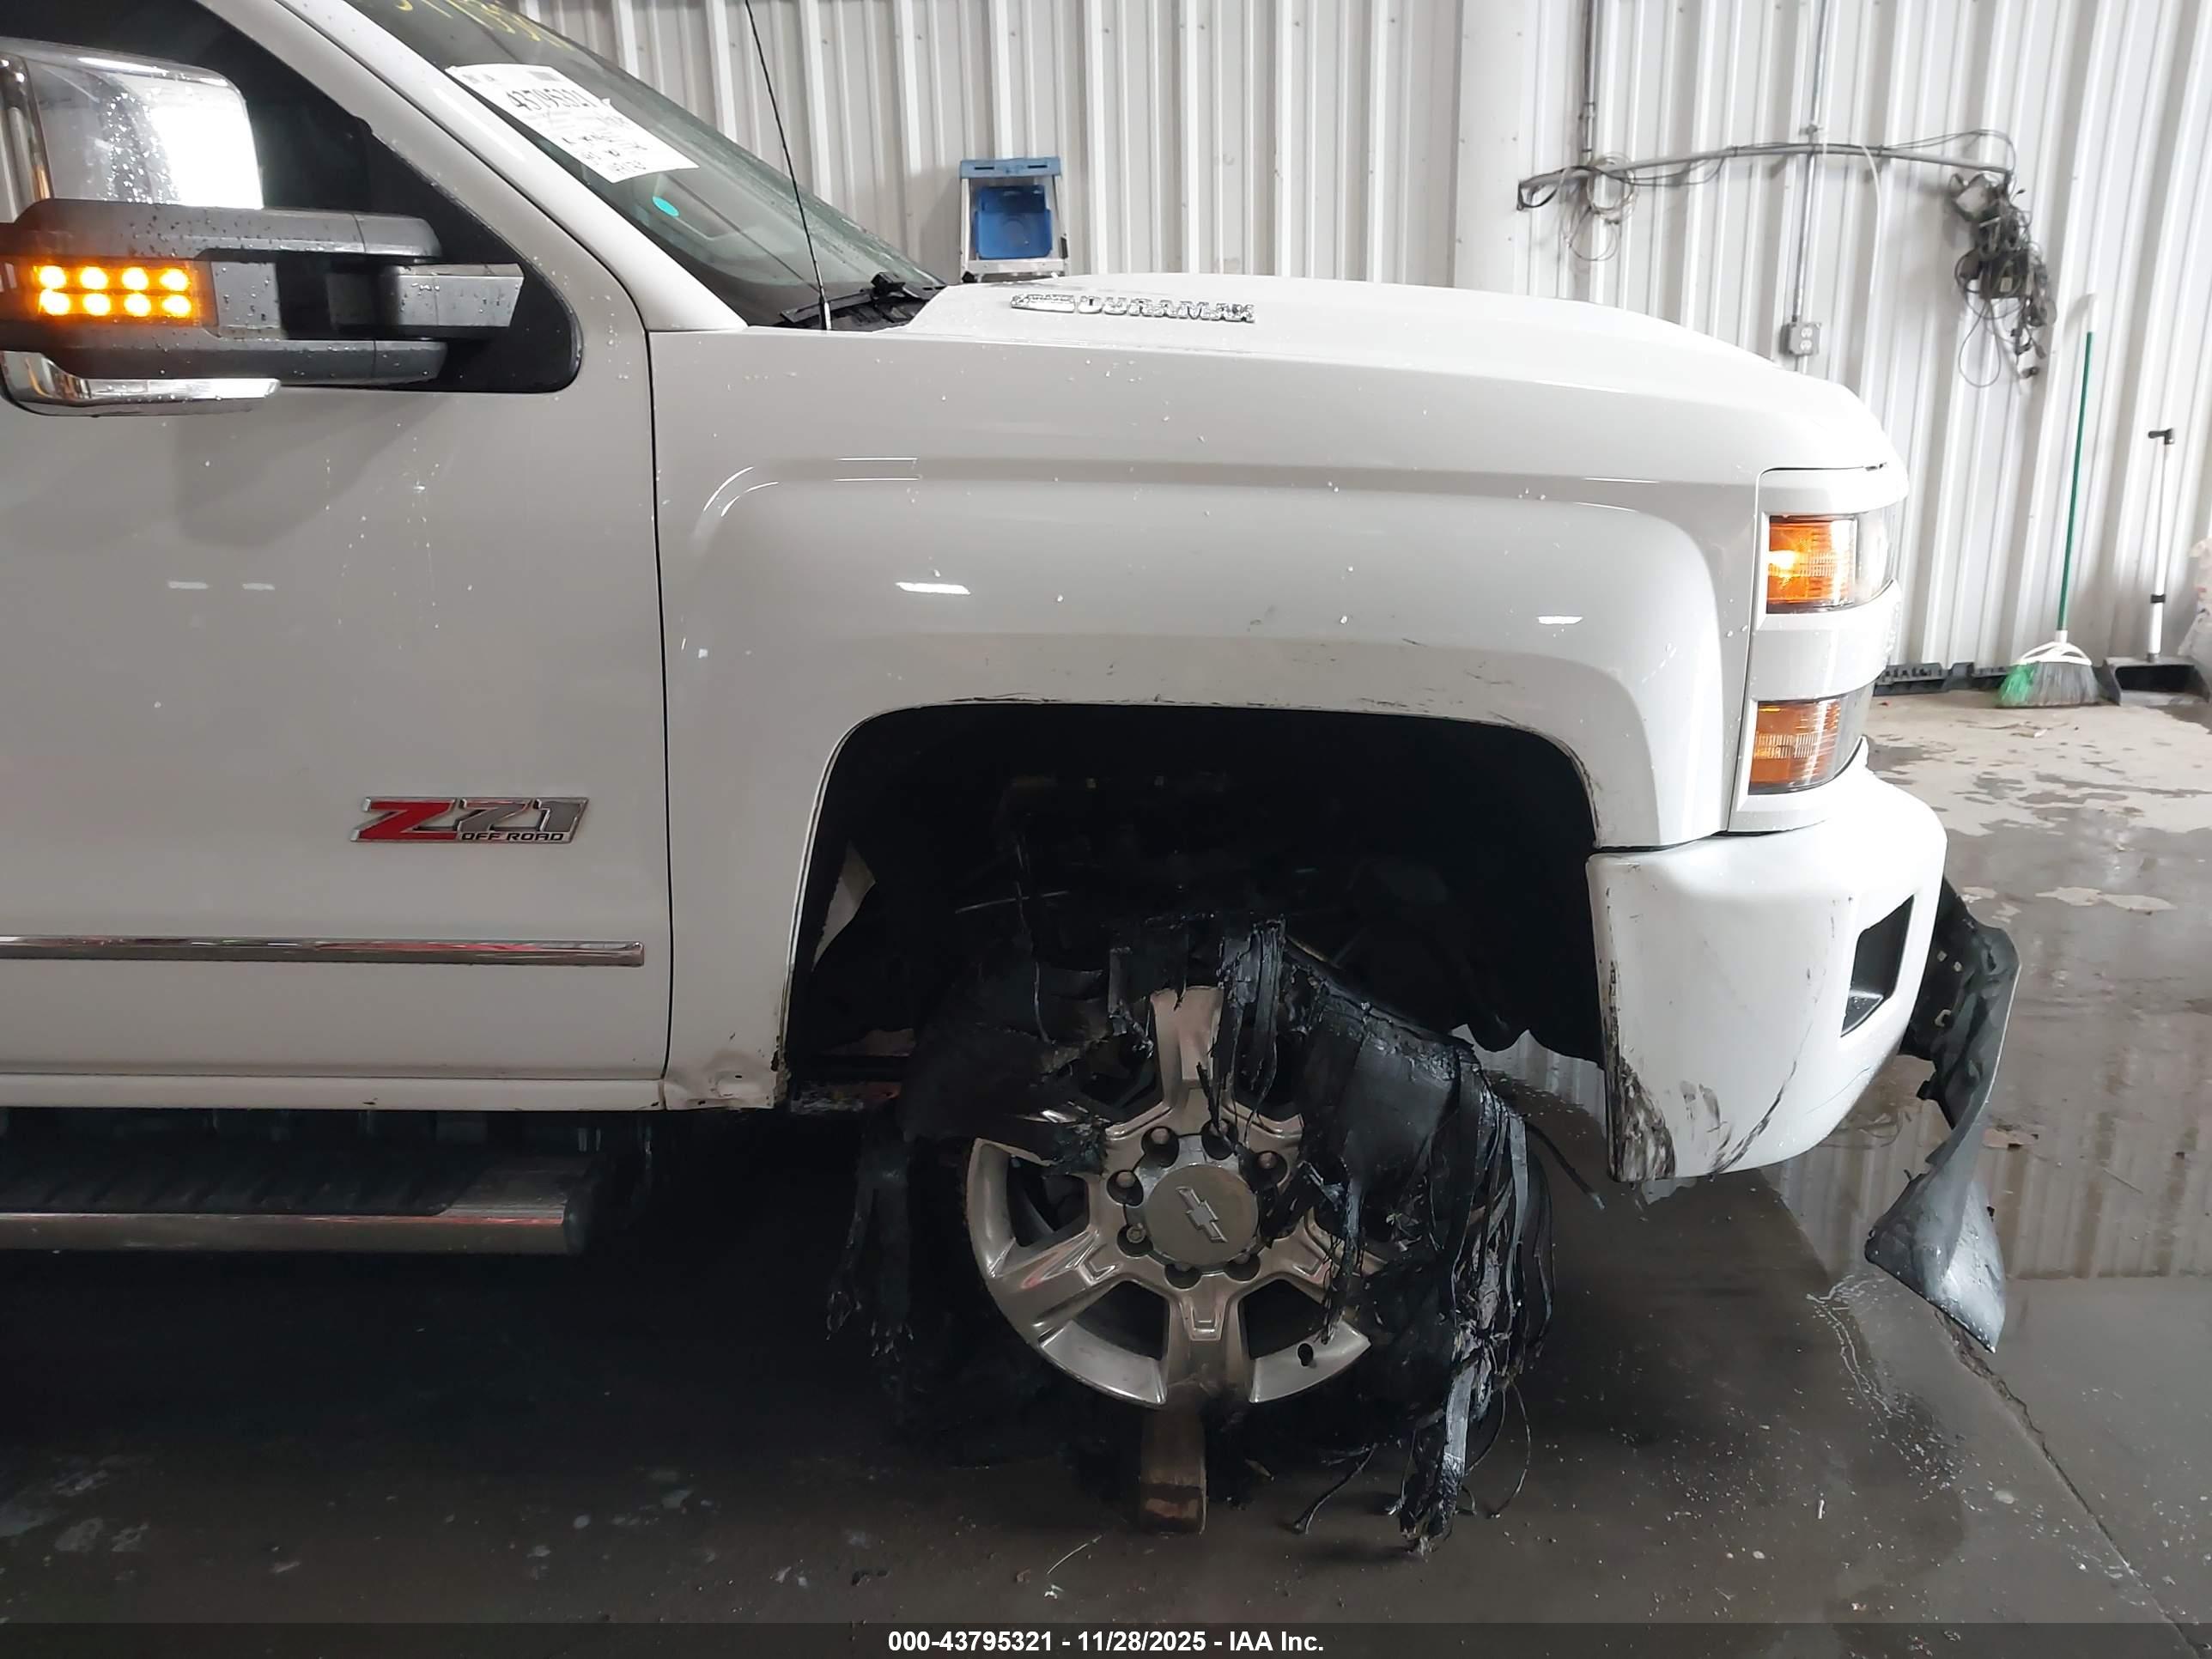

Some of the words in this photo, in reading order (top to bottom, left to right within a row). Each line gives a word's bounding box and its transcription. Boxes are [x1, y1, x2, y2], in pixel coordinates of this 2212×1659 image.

[1079, 295, 1255, 323] DURAMAX
[351, 797, 589, 843] Z71
[461, 832, 501, 841] OFF
[507, 832, 564, 842] ROAD
